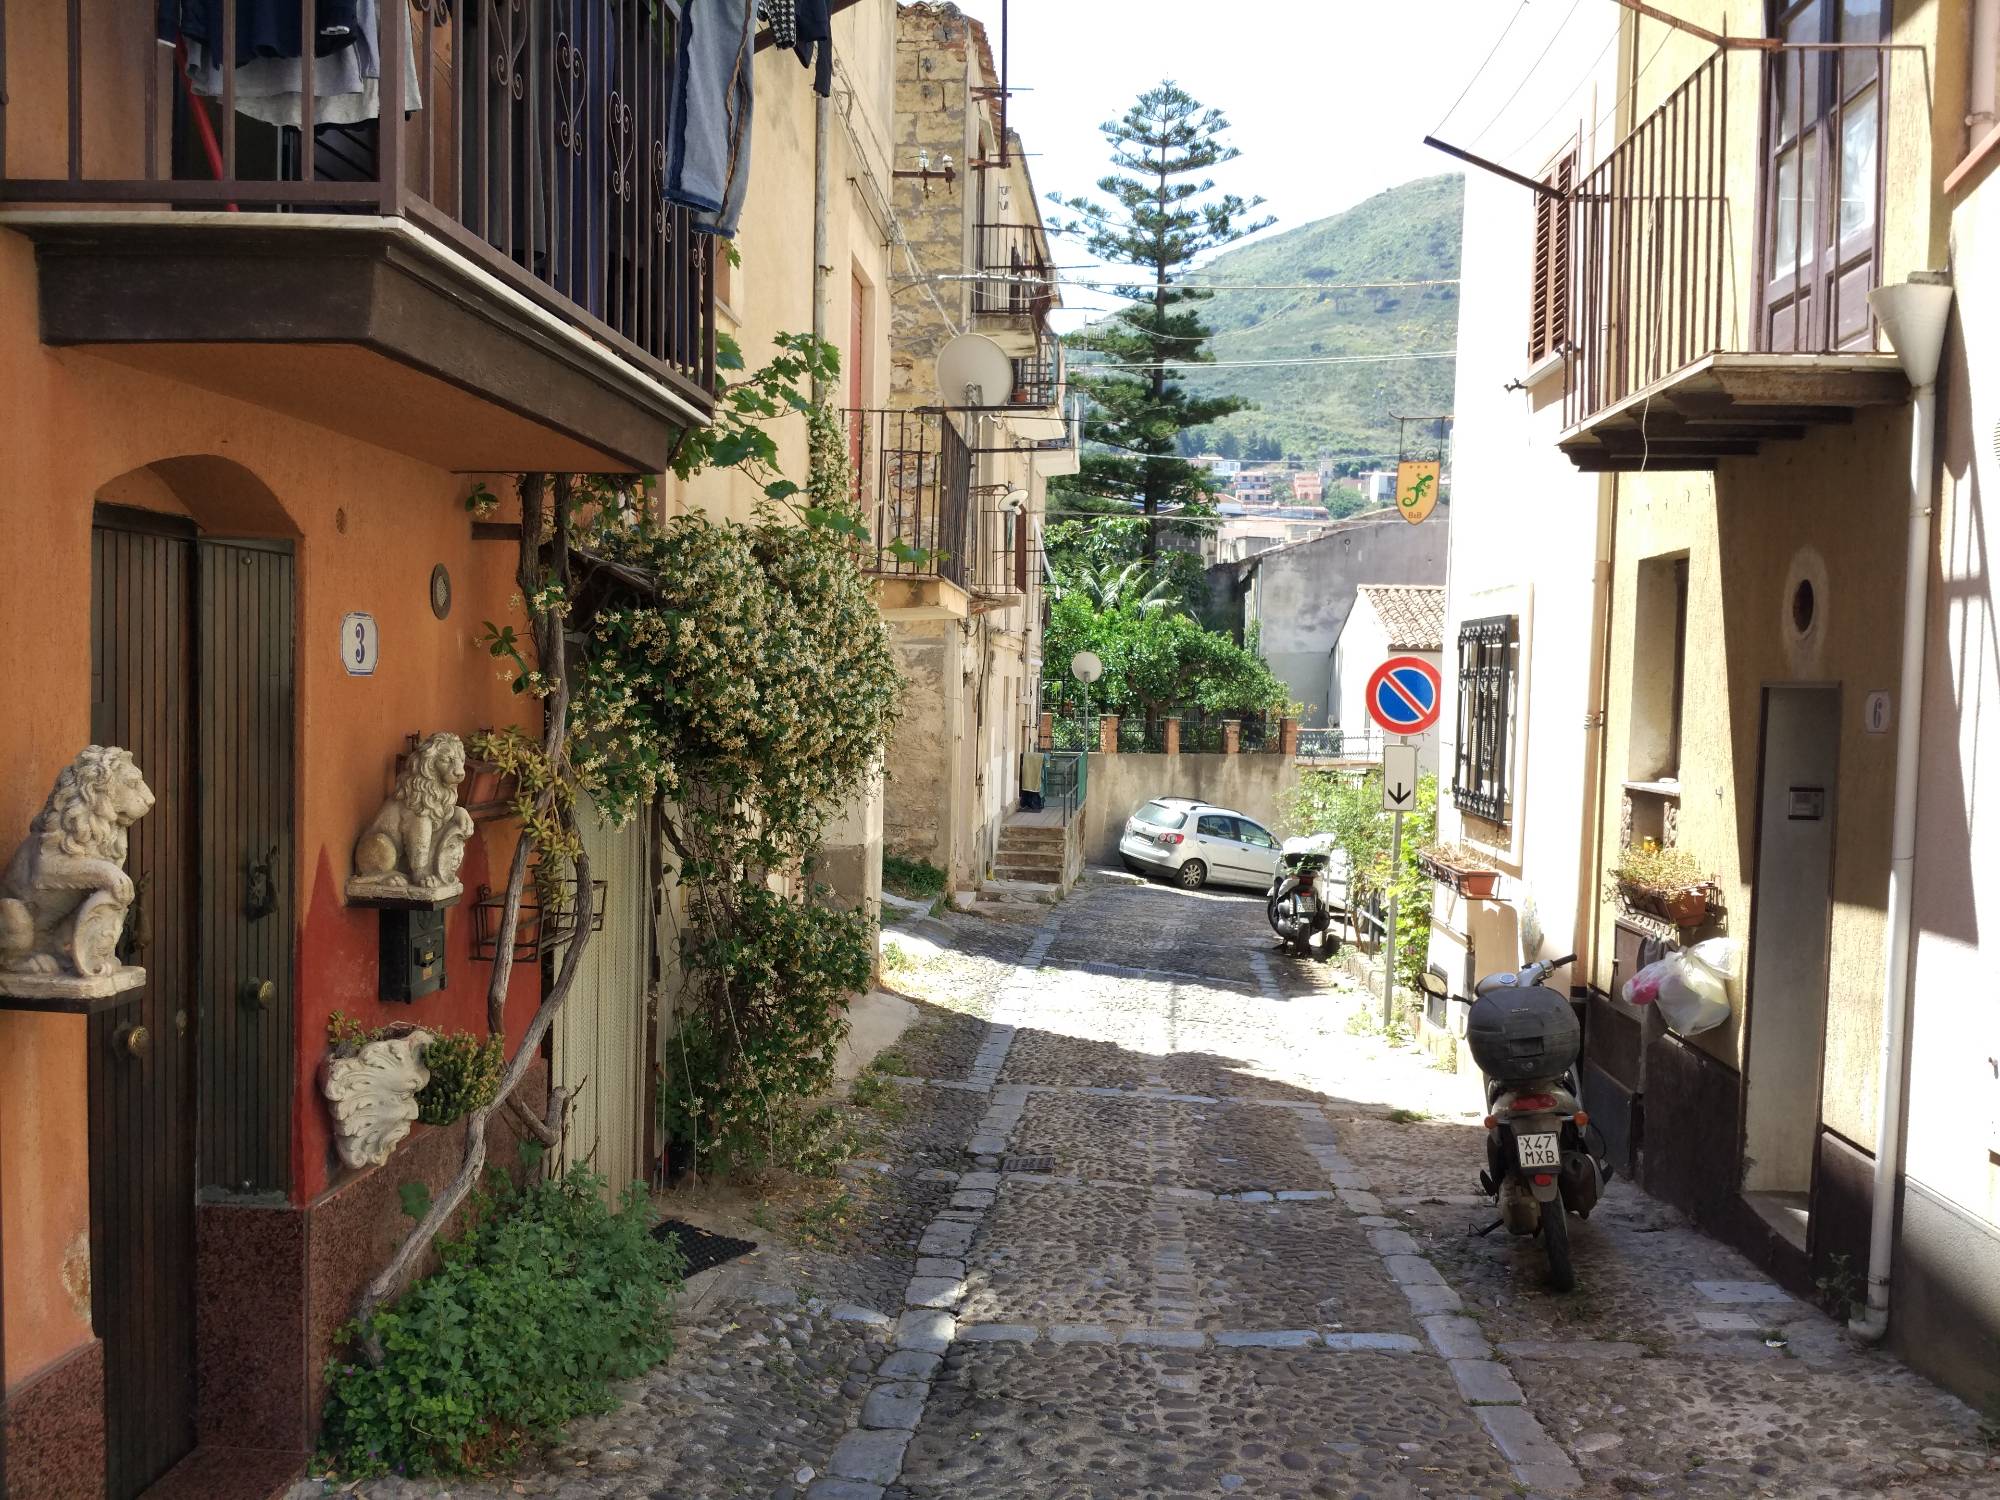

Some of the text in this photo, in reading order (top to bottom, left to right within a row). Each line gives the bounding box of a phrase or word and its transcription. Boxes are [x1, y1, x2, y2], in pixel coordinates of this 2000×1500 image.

[355, 622, 365, 664] 3
[1873, 697, 1882, 729] 6
[1523, 1135, 1552, 1150] X47
[1525, 1150, 1555, 1165] MXB
